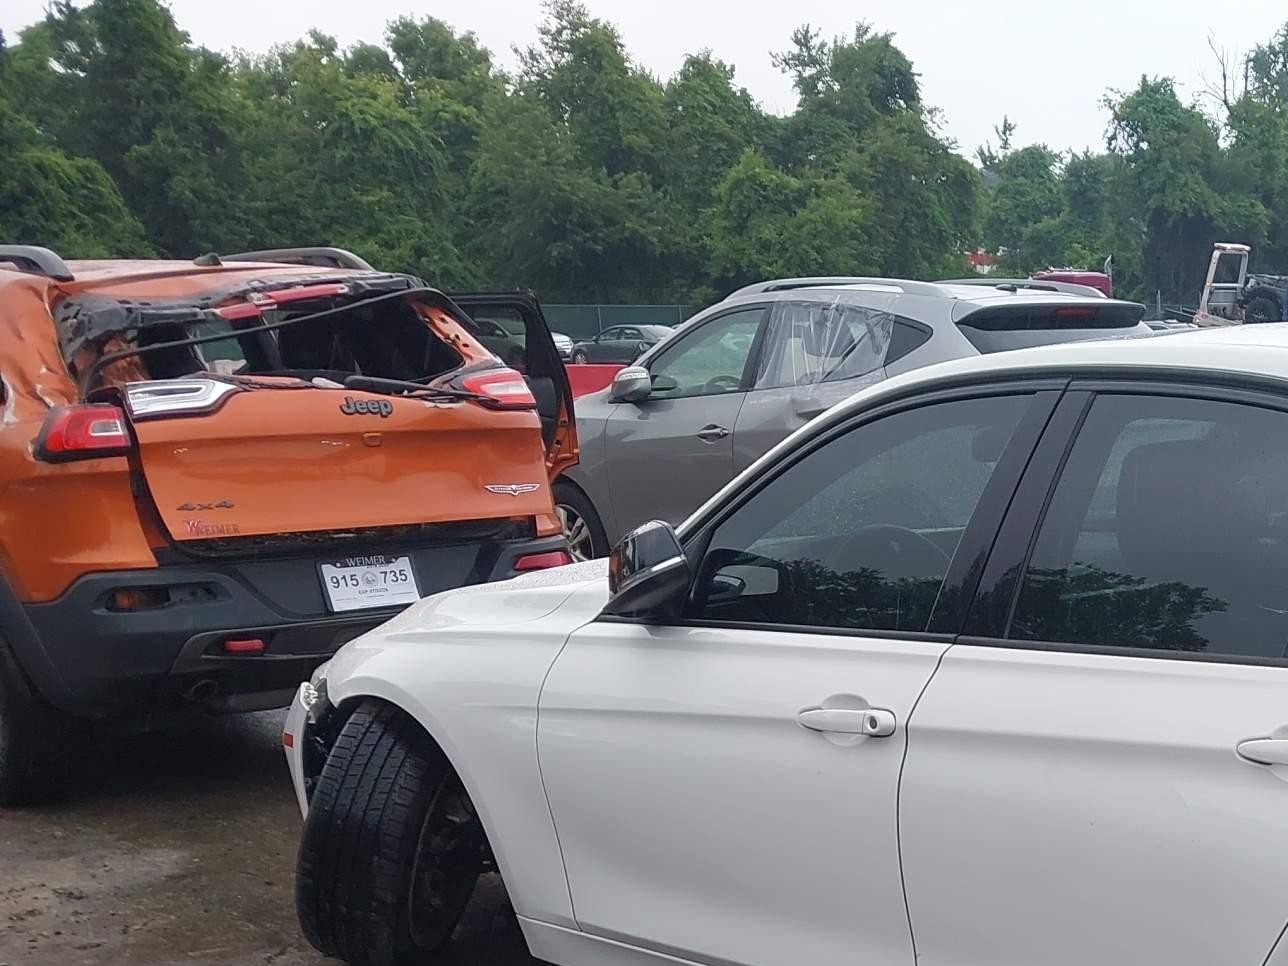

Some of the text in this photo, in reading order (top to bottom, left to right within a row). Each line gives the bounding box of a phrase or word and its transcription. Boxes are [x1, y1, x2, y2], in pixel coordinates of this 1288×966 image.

[340, 396, 394, 418] Jeep
[345, 555, 386, 567] WEIMER
[330, 569, 408, 588] 915 735
